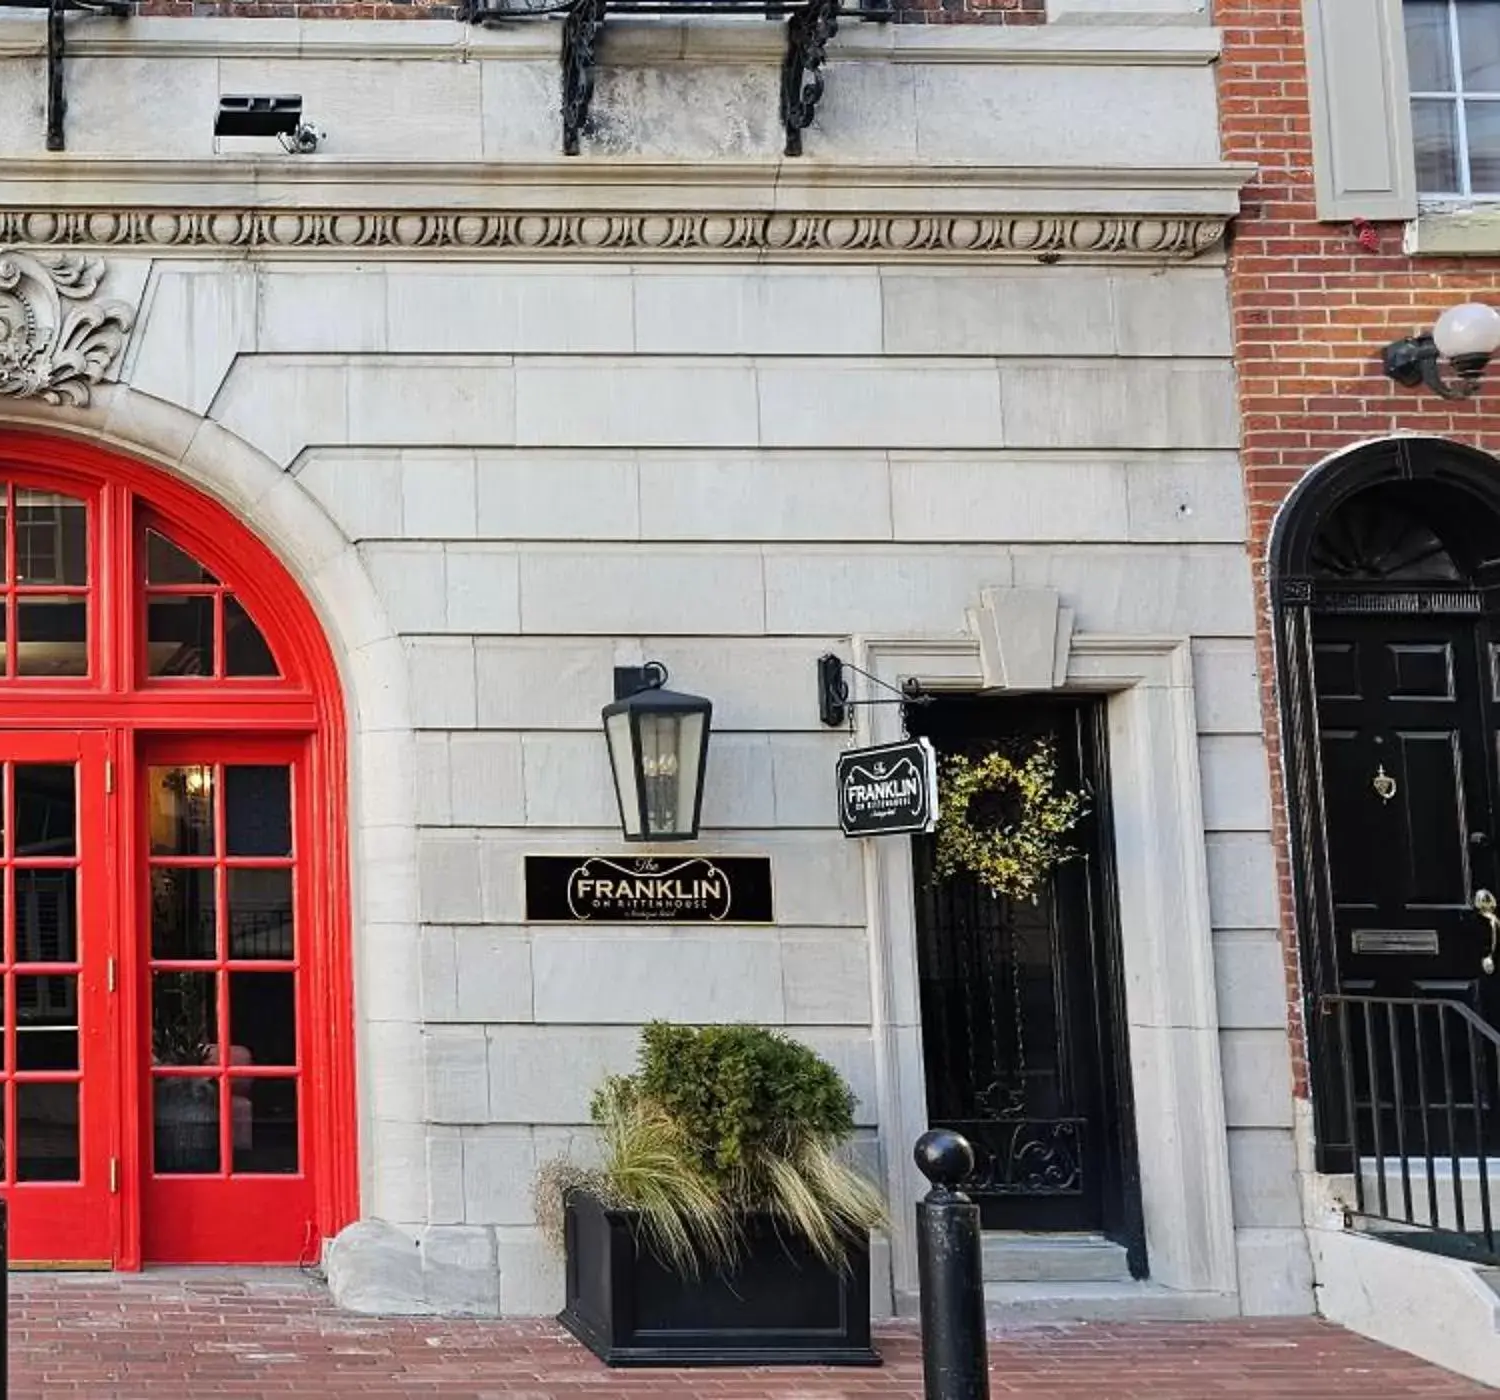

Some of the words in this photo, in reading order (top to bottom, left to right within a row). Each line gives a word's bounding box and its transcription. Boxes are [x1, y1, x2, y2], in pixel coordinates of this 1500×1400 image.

[848, 777, 917, 804] FRANKLIN
[633, 857, 660, 873] The
[576, 879, 721, 899] FRANKLIN
[591, 899, 611, 908] ON
